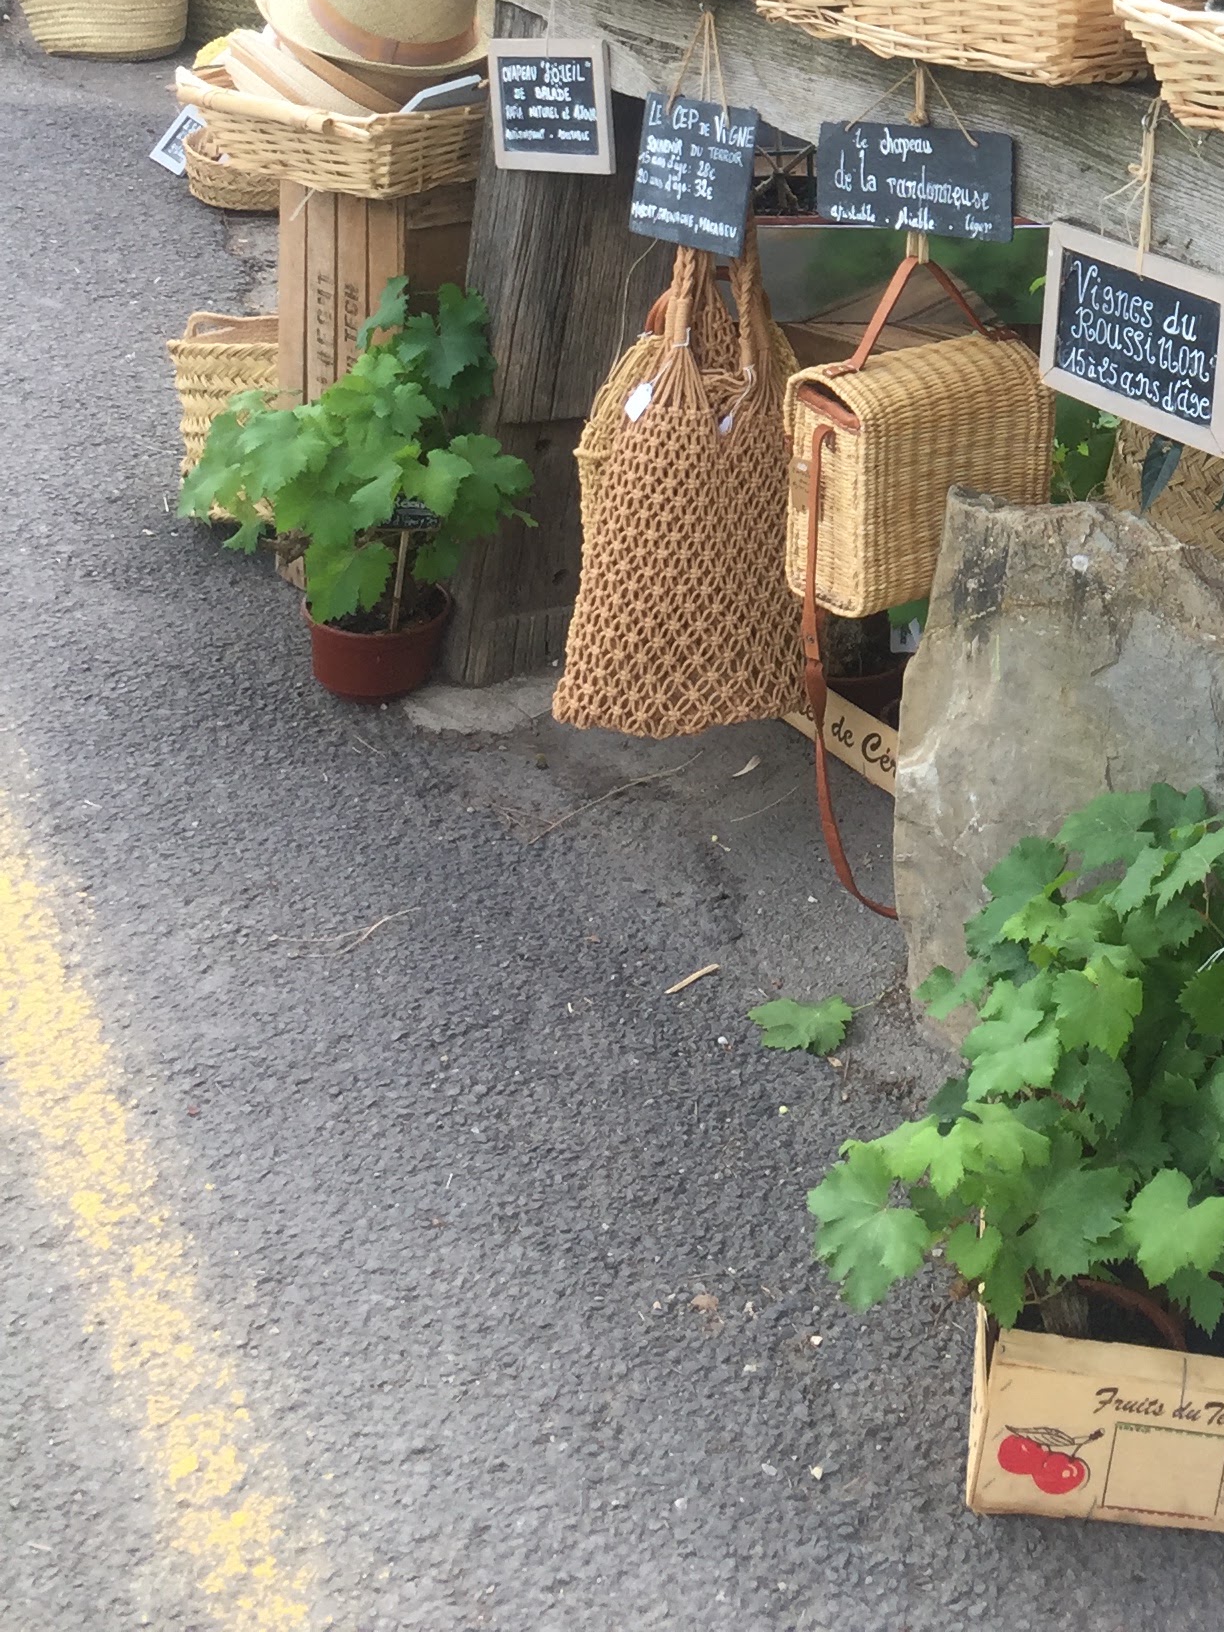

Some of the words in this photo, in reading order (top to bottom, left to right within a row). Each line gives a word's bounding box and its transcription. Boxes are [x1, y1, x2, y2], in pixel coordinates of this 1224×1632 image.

[649, 100, 663, 126] LE
[673, 105, 700, 130] CEP
[690, 144, 704, 157] DU
[879, 126, 934, 162] chapeau
[834, 149, 852, 193] de
[859, 149, 877, 192] la
[886, 165, 991, 211] randonneuse
[1073, 260, 1154, 328] Vignes
[1162, 300, 1197, 342] du
[1063, 346, 1086, 376] 15
[1087, 356, 1097, 378] à
[1097, 356, 1119, 385] 25
[1120, 371, 1160, 403] ans
[831, 716, 855, 748] de
[1093, 1387, 1166, 1417] Fruits
[1172, 1401, 1202, 1422] du
